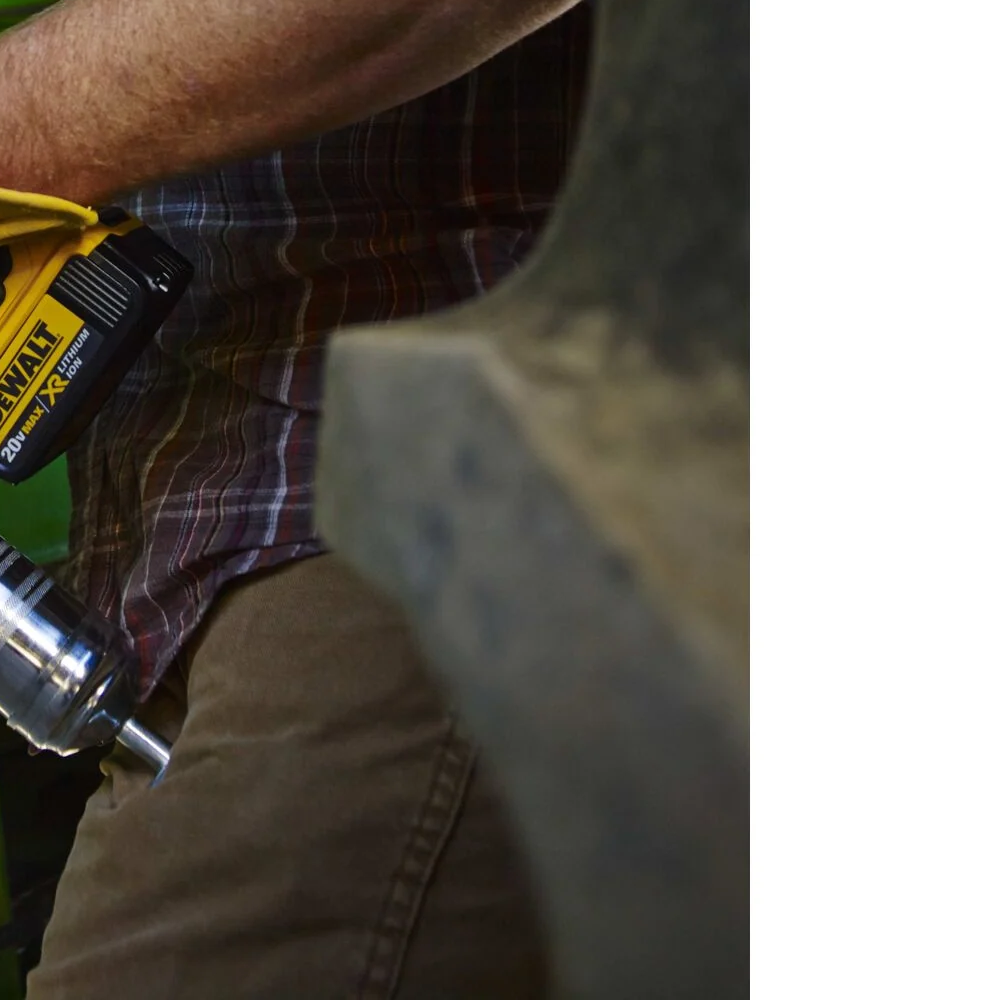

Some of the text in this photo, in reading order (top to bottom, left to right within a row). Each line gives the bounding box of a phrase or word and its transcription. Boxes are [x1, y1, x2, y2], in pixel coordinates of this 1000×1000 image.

[57, 328, 90, 374] LITHIUM
[65, 356, 83, 380] ION
[21, 405, 44, 434] MAX
[39, 373, 70, 406] XR
